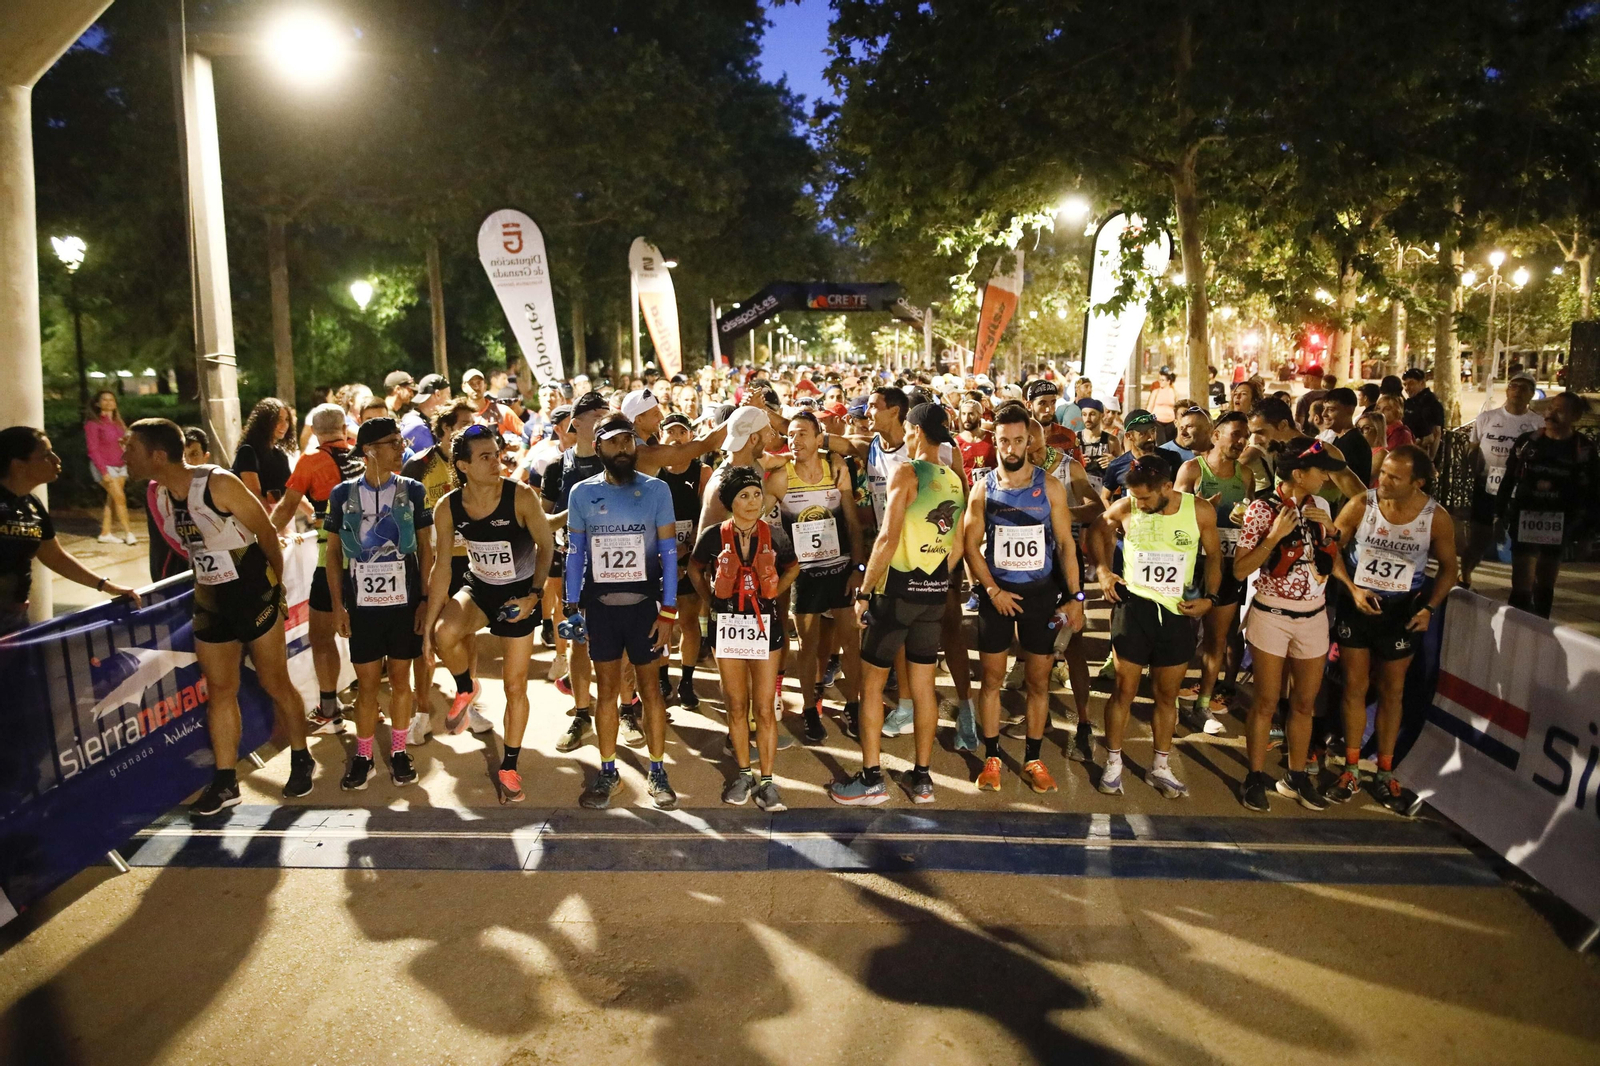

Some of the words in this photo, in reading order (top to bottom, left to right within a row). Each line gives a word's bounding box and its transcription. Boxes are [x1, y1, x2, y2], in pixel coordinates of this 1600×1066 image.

[721, 295, 779, 332] alssport.es
[1489, 475, 1502, 484] 10
[769, 505, 779, 519] 3
[1521, 520, 1562, 532] 1003B
[677, 531, 691, 542] 6A
[812, 534, 822, 549] 5
[1365, 536, 1420, 551] MARACENA
[802, 549, 838, 559] alssport.es
[1003, 541, 1038, 557] 106
[1221, 541, 1237, 555] 37
[195, 556, 219, 573] 2
[468, 549, 511, 565] 1017B
[601, 551, 636, 568] 122
[1001, 560, 1043, 568] alssport.es
[600, 571, 642, 579] alssport.es
[1142, 565, 1178, 583] 192
[1365, 559, 1406, 579] 437
[363, 575, 396, 593] 321
[1362, 576, 1407, 590] alssport.es
[364, 593, 405, 604] alssport.es
[719, 626, 768, 641] 1013A
[723, 647, 766, 656] alssport.es
[109, 746, 155, 779] granada
